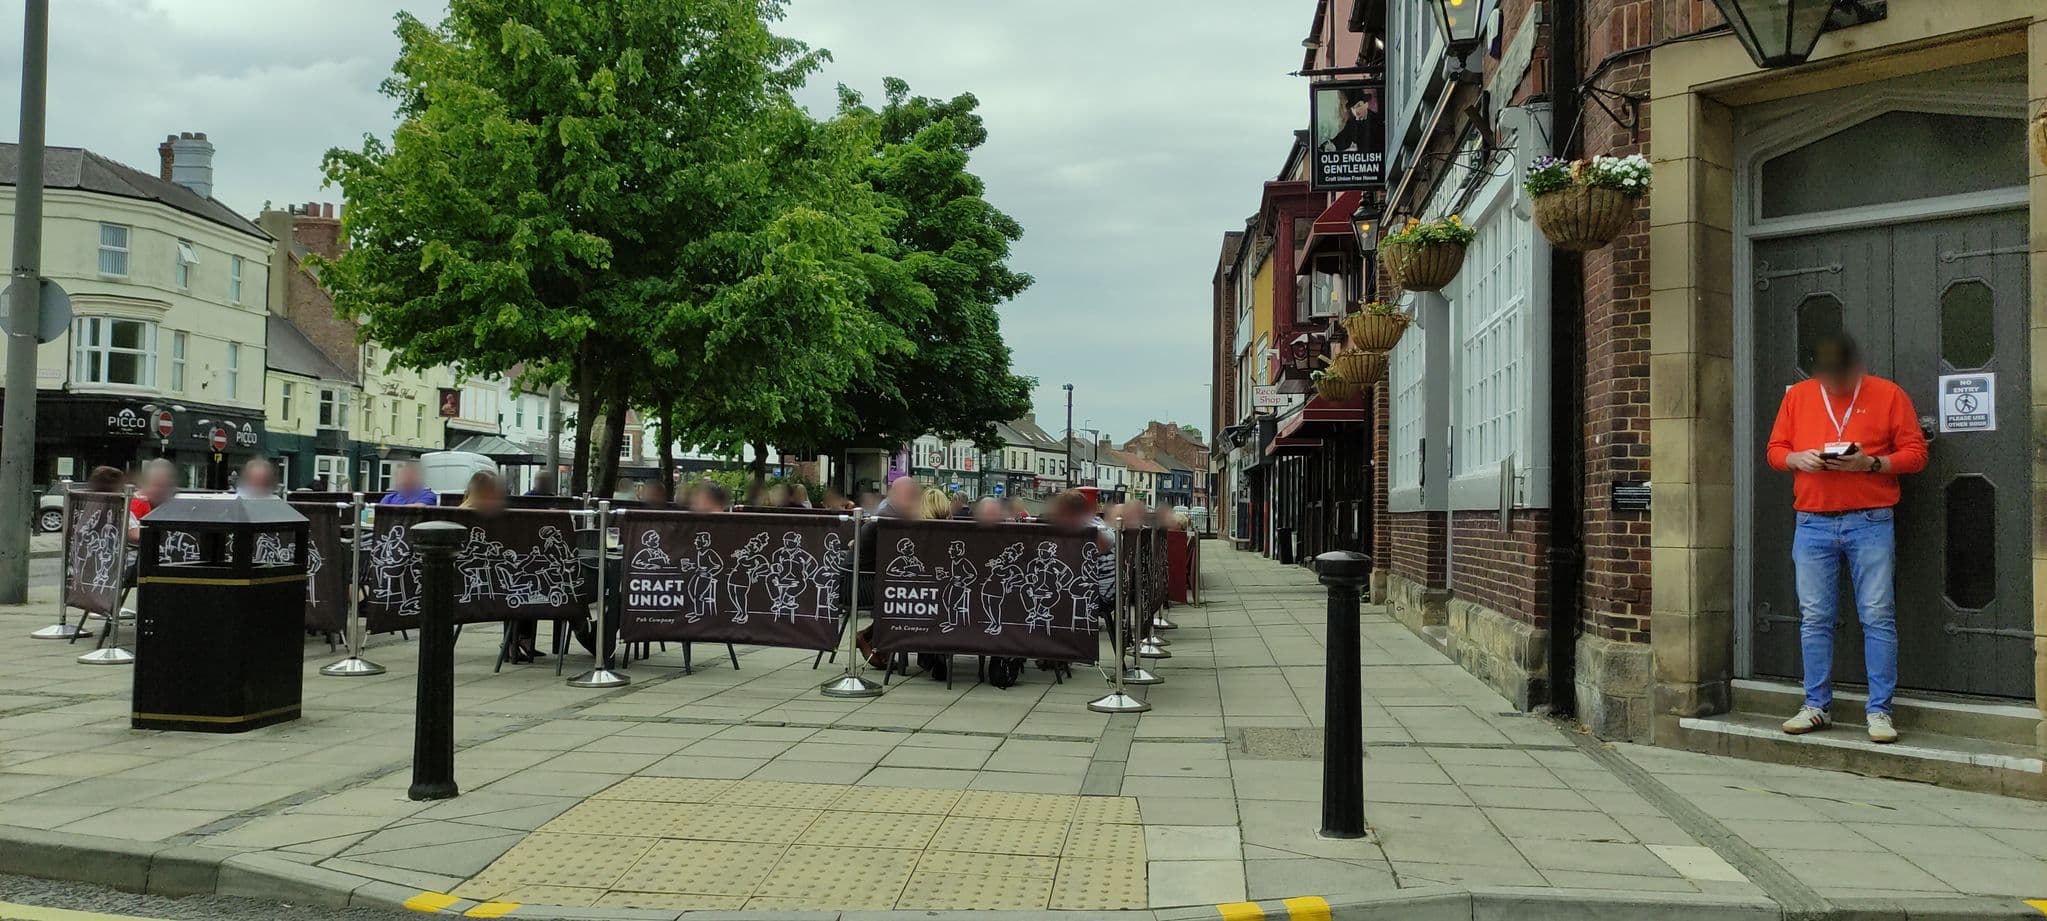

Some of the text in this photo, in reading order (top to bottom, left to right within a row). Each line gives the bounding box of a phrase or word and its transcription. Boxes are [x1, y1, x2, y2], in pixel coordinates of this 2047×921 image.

[1321, 152, 1382, 164] OLD ENGLISH
[1323, 163, 1380, 174] GENTLEMAN
[1255, 387, 1277, 395] Reco
[1260, 395, 1281, 404] Shop
[108, 416, 146, 428] PICCO
[236, 431, 257, 444] PICCO
[930, 456, 941, 464] 30
[629, 579, 685, 592] CRAFT
[884, 586, 939, 600] CRAFT
[629, 594, 684, 606] UNION
[884, 602, 939, 615] UNION
[648, 616, 675, 624] Company
